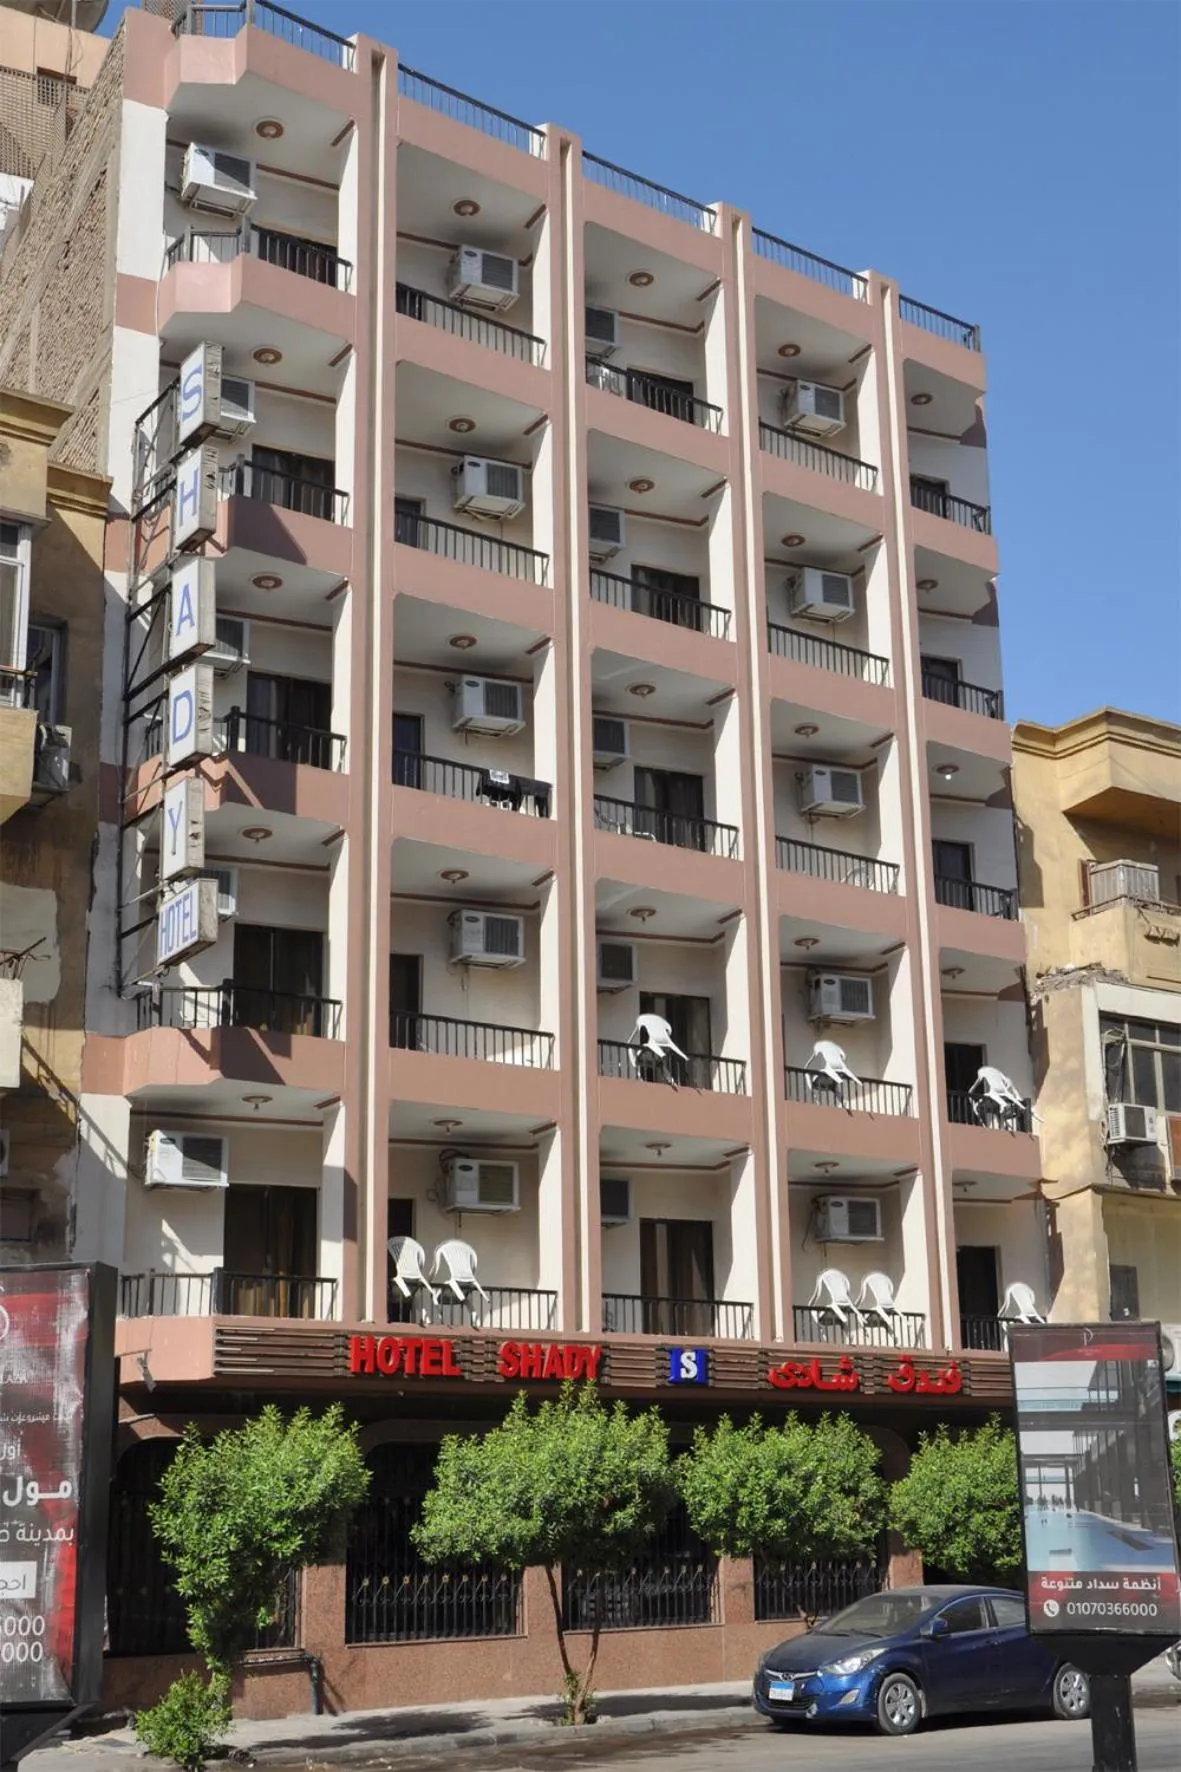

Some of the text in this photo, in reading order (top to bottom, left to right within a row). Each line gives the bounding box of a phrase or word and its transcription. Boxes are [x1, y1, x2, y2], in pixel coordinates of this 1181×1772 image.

[160, 891, 197, 955] HOTEL
[350, 1334, 600, 1380] HOTEL SHADY
[679, 1352, 698, 1379] S
[887, 1354, 962, 1394] فندق
[16, 1522, 74, 1547] بمدينة
[1041, 1576, 1161, 1591] أنظمة سداد متنوعة
[1066, 1602, 1158, 1617] 01070366000
[0, 1615, 45, 1636] 000
